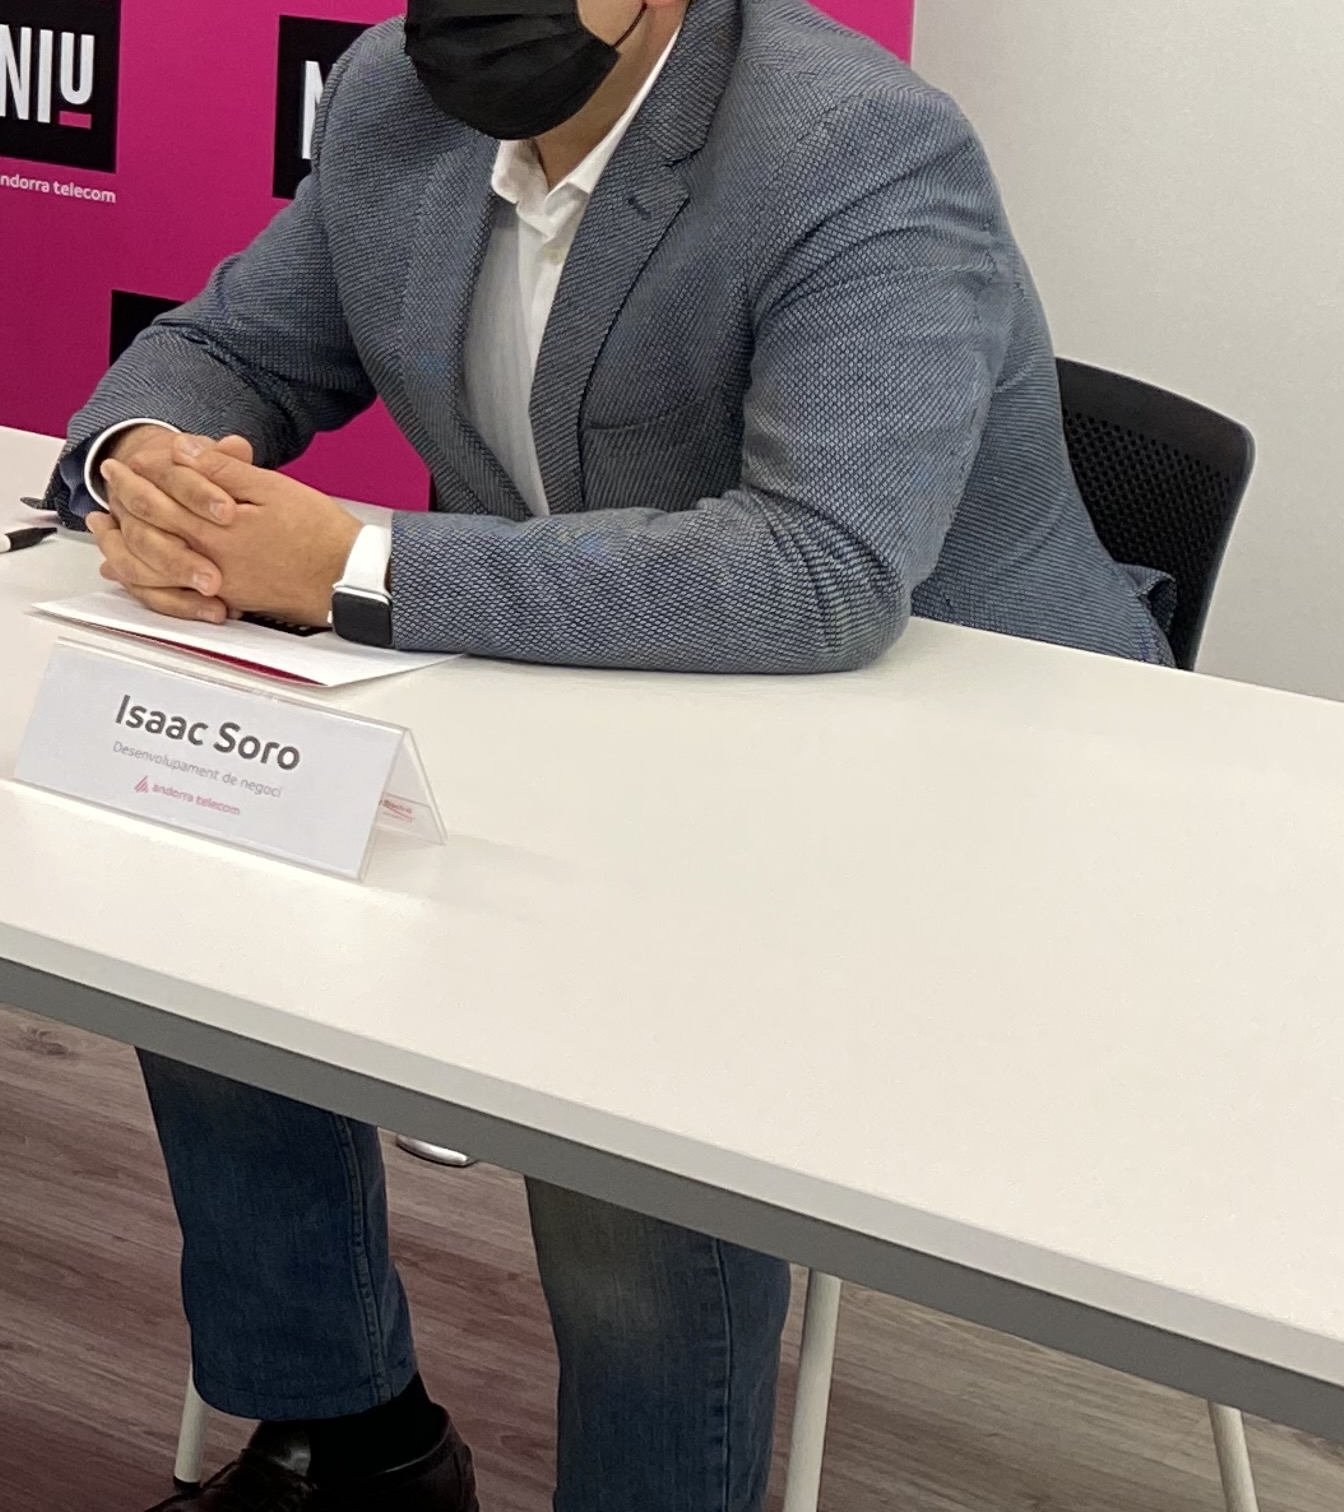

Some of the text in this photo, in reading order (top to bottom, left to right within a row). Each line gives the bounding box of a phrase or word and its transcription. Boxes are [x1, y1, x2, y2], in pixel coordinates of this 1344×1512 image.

[52, 181, 116, 203] telecom
[115, 694, 301, 771] Isaac Soro
[113, 740, 220, 782] Desenvolupament
[222, 772, 239, 786] de
